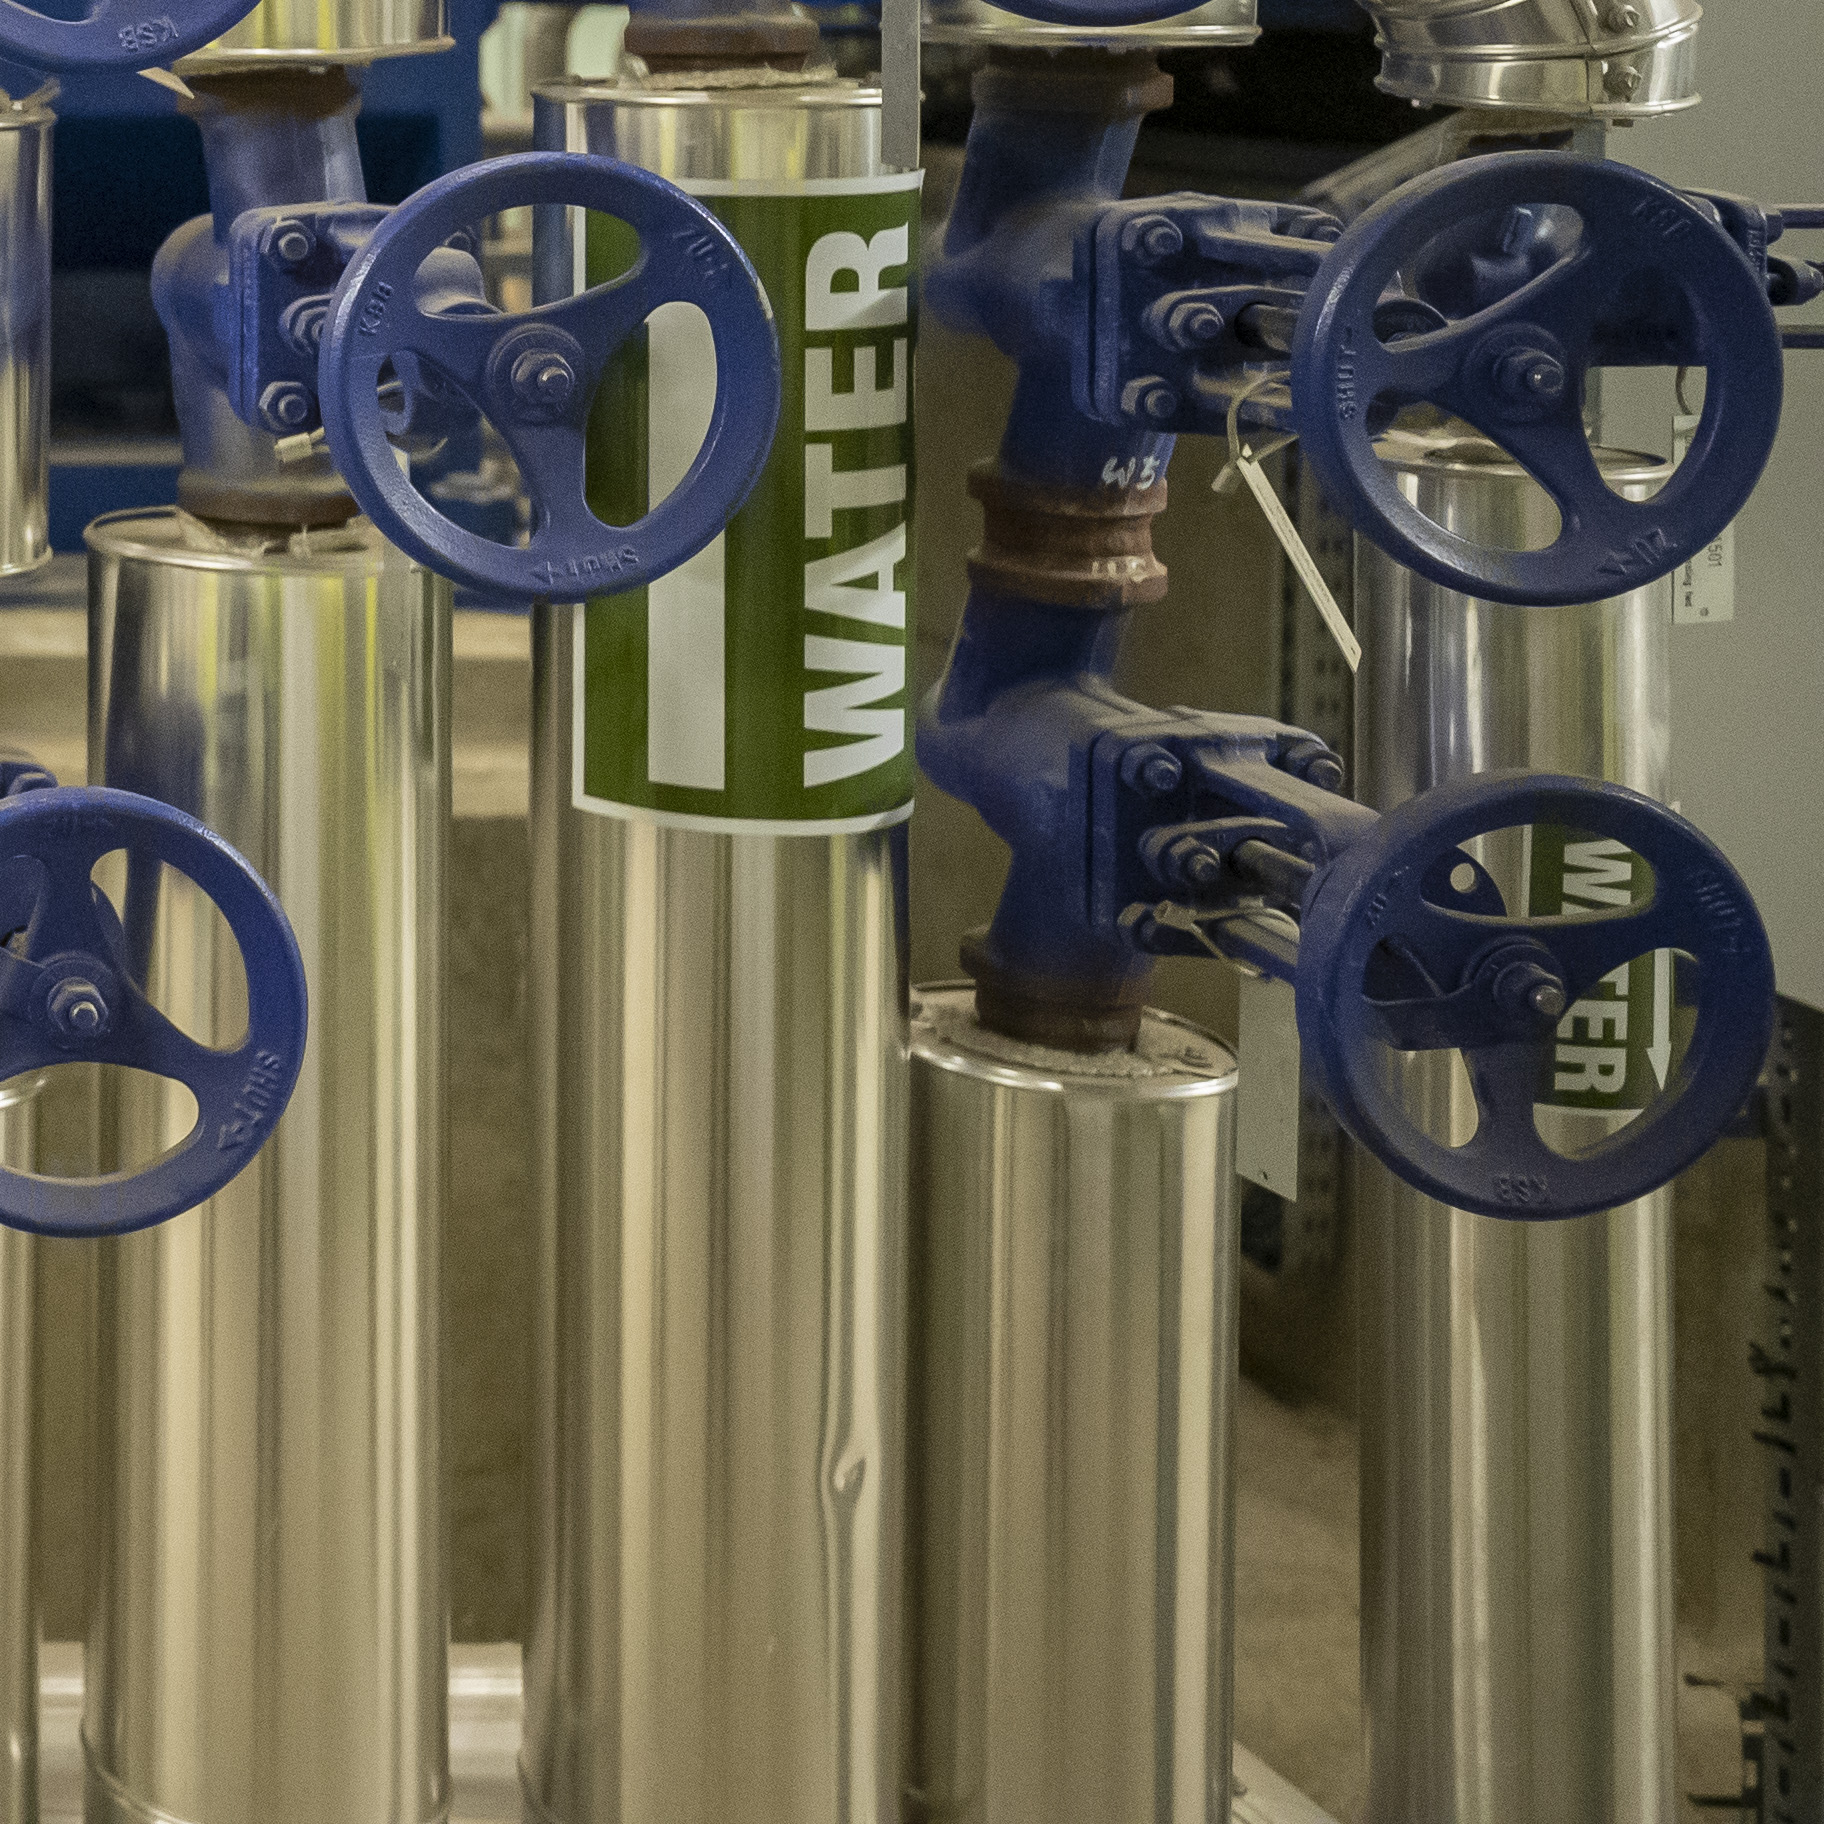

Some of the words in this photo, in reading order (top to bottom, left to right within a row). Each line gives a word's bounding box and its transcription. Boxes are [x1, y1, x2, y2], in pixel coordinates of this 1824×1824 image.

[118, 17, 179, 54] KSB
[1335, 342, 1358, 419] SHUT
[804, 221, 909, 789] WATER
[1555, 839, 1632, 1093] WER
